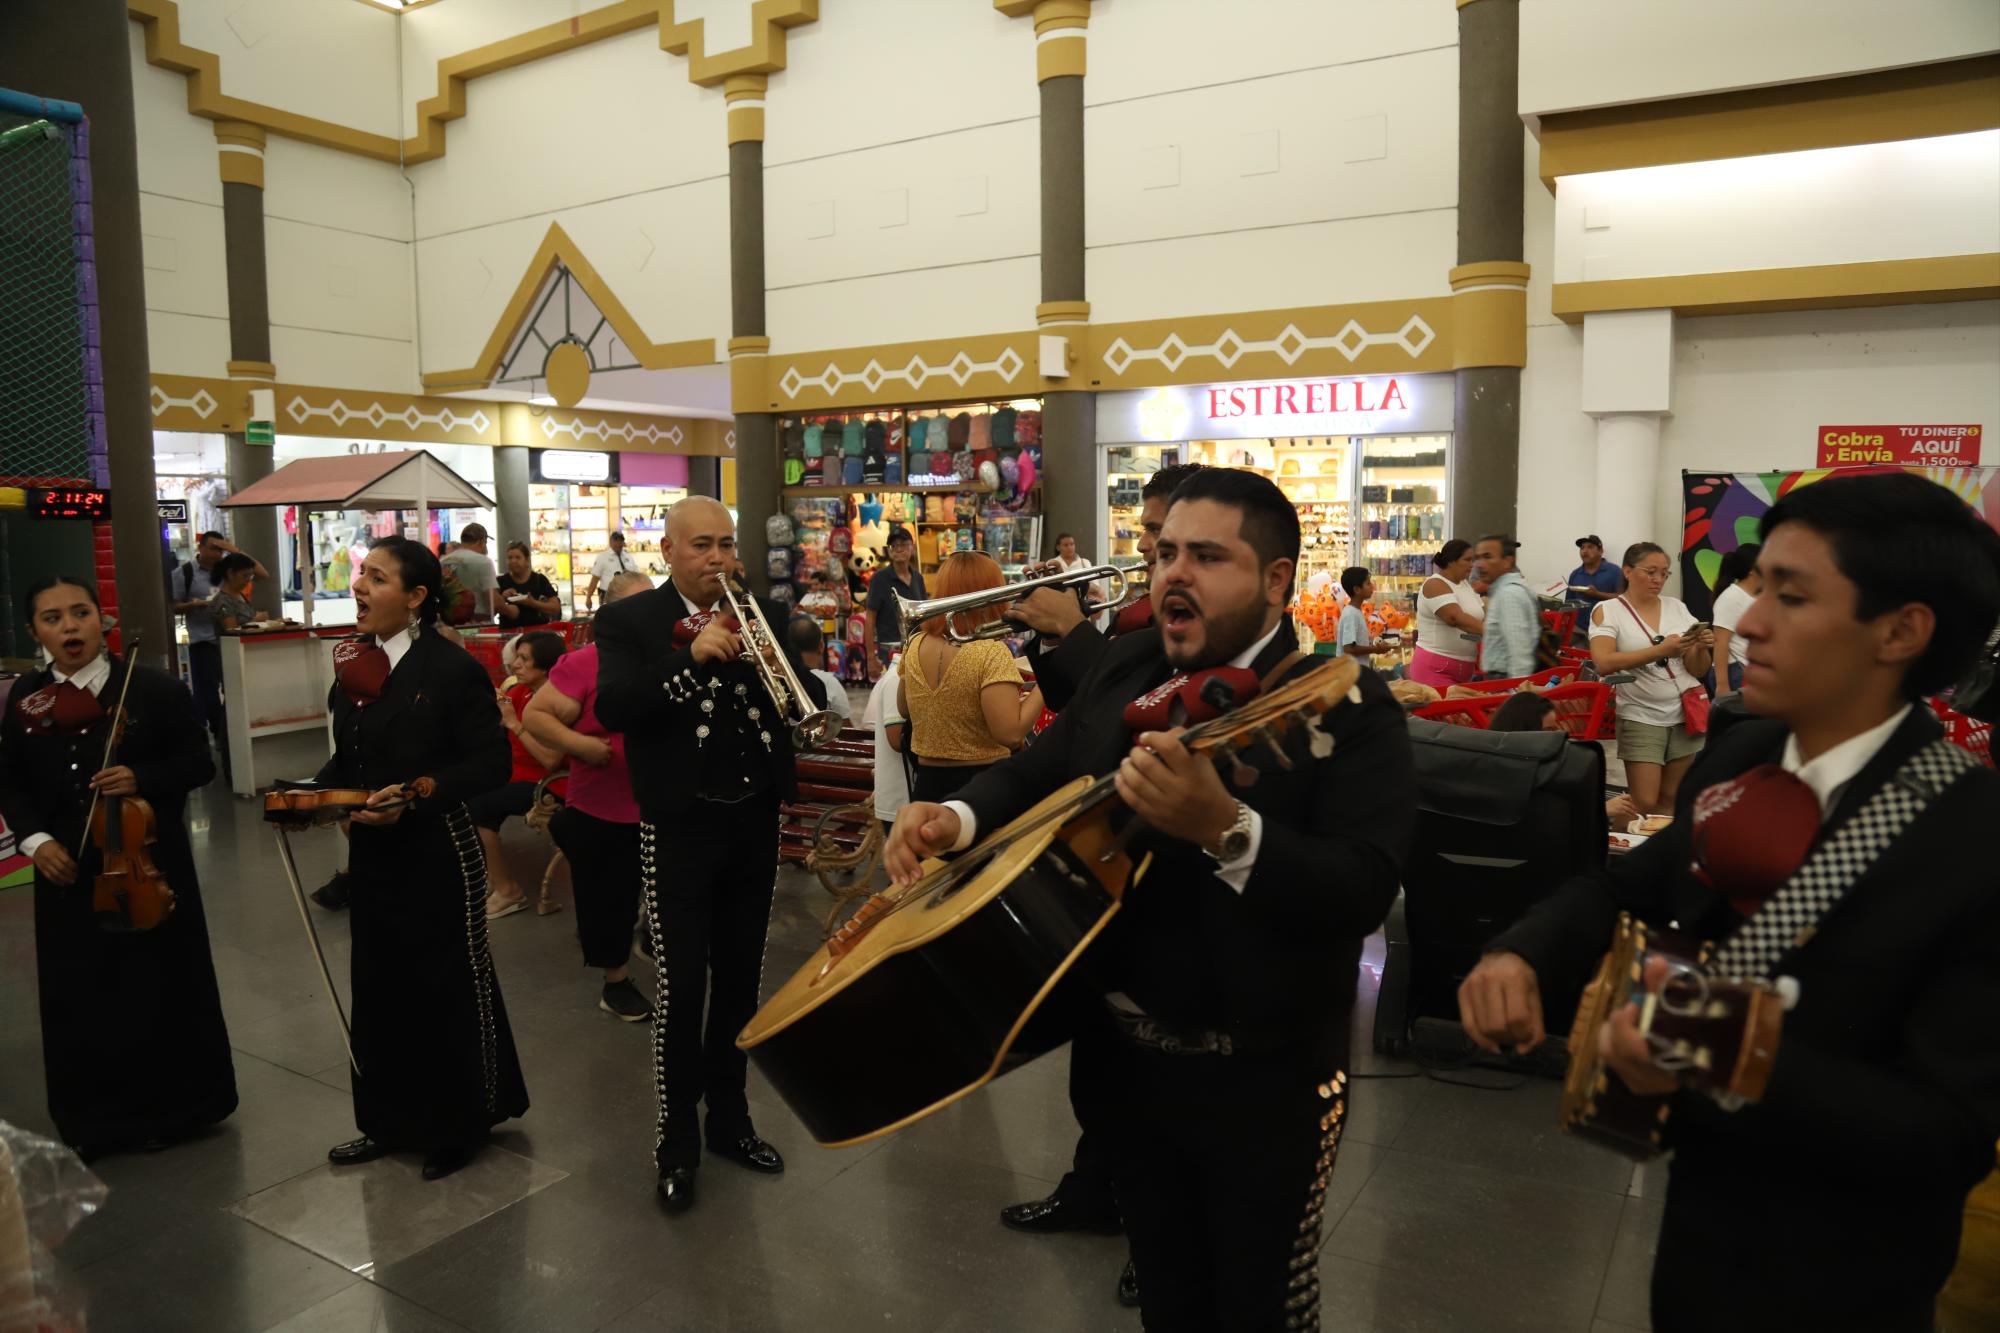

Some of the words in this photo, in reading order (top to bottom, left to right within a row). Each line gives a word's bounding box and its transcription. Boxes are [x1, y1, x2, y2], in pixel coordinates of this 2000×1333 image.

[1208, 378, 1407, 418] ESTRELLA
[1823, 432, 1885, 446] Cobra
[1899, 427, 1919, 437] TU
[1910, 437, 1962, 454] AQUÍ
[1825, 453, 1834, 463] y
[1838, 446, 1893, 462] Envía
